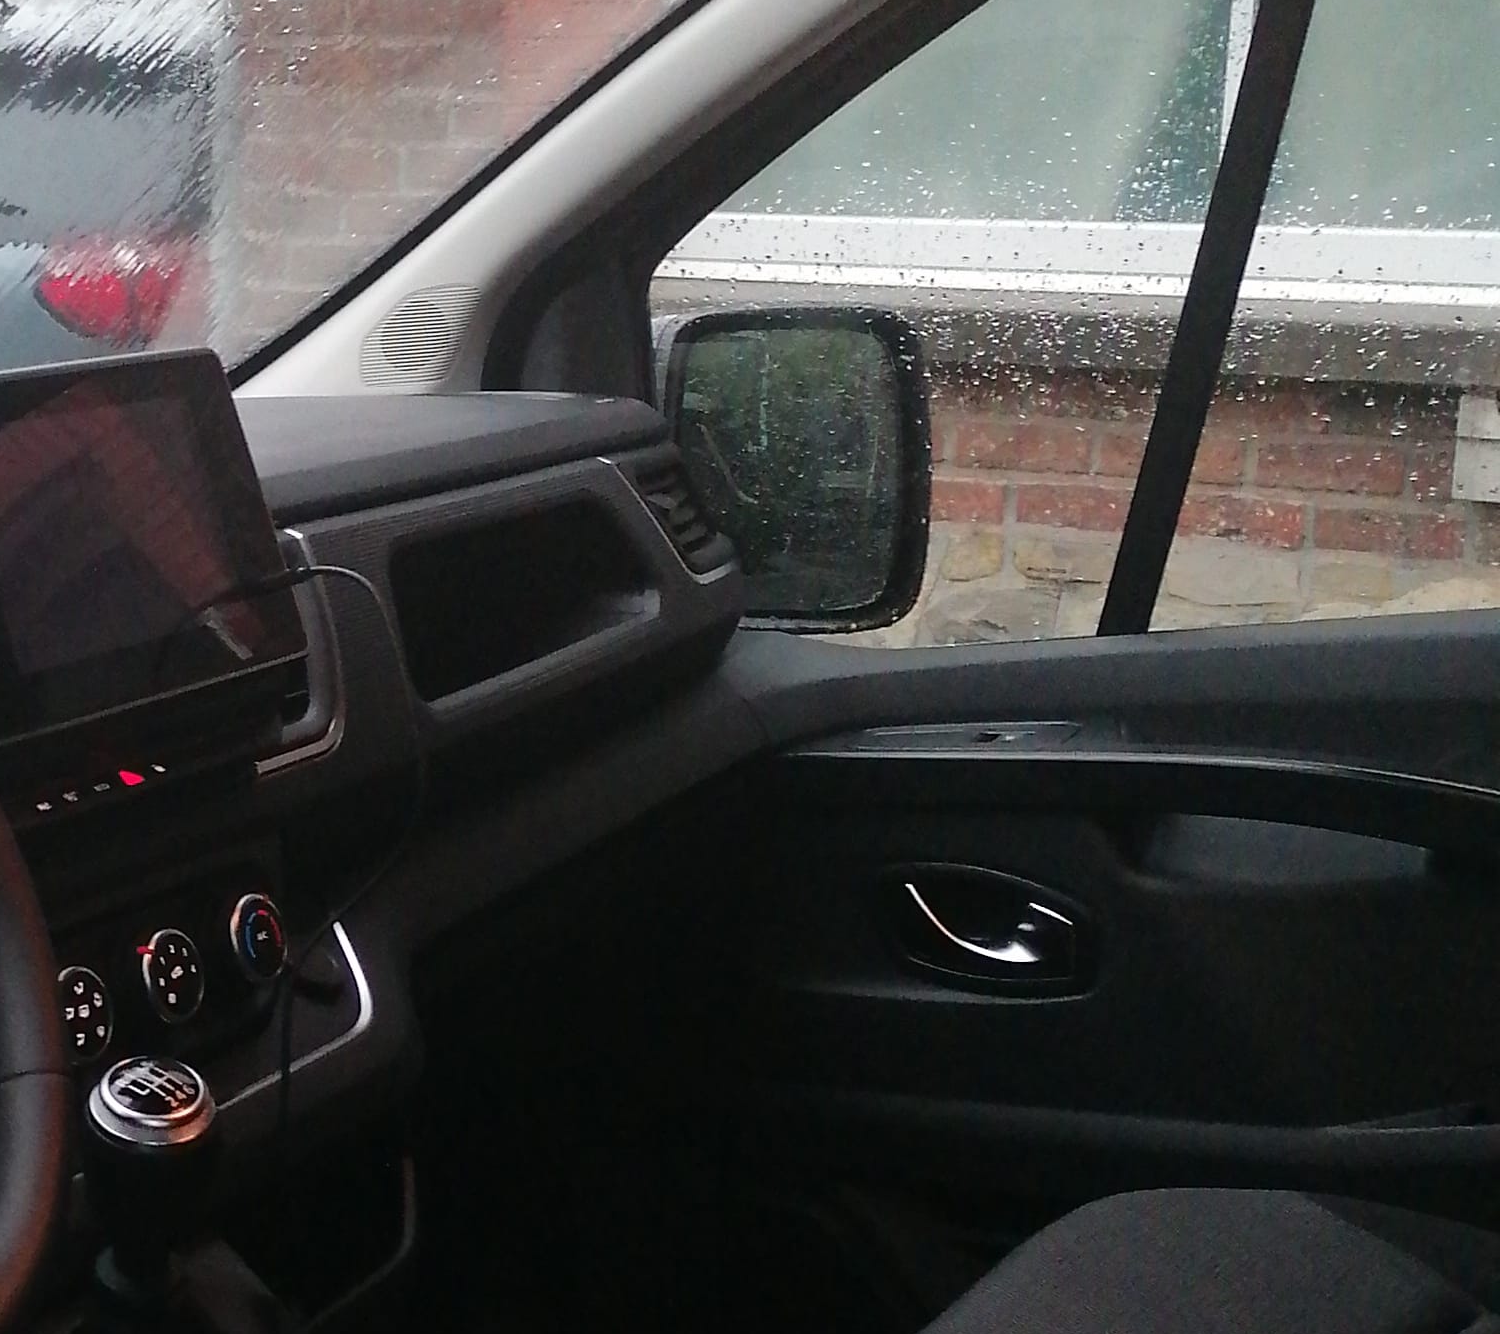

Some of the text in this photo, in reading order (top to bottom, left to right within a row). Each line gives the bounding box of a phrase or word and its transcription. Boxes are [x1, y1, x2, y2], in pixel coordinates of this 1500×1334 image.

[164, 1083, 196, 1107] 2 4 6
